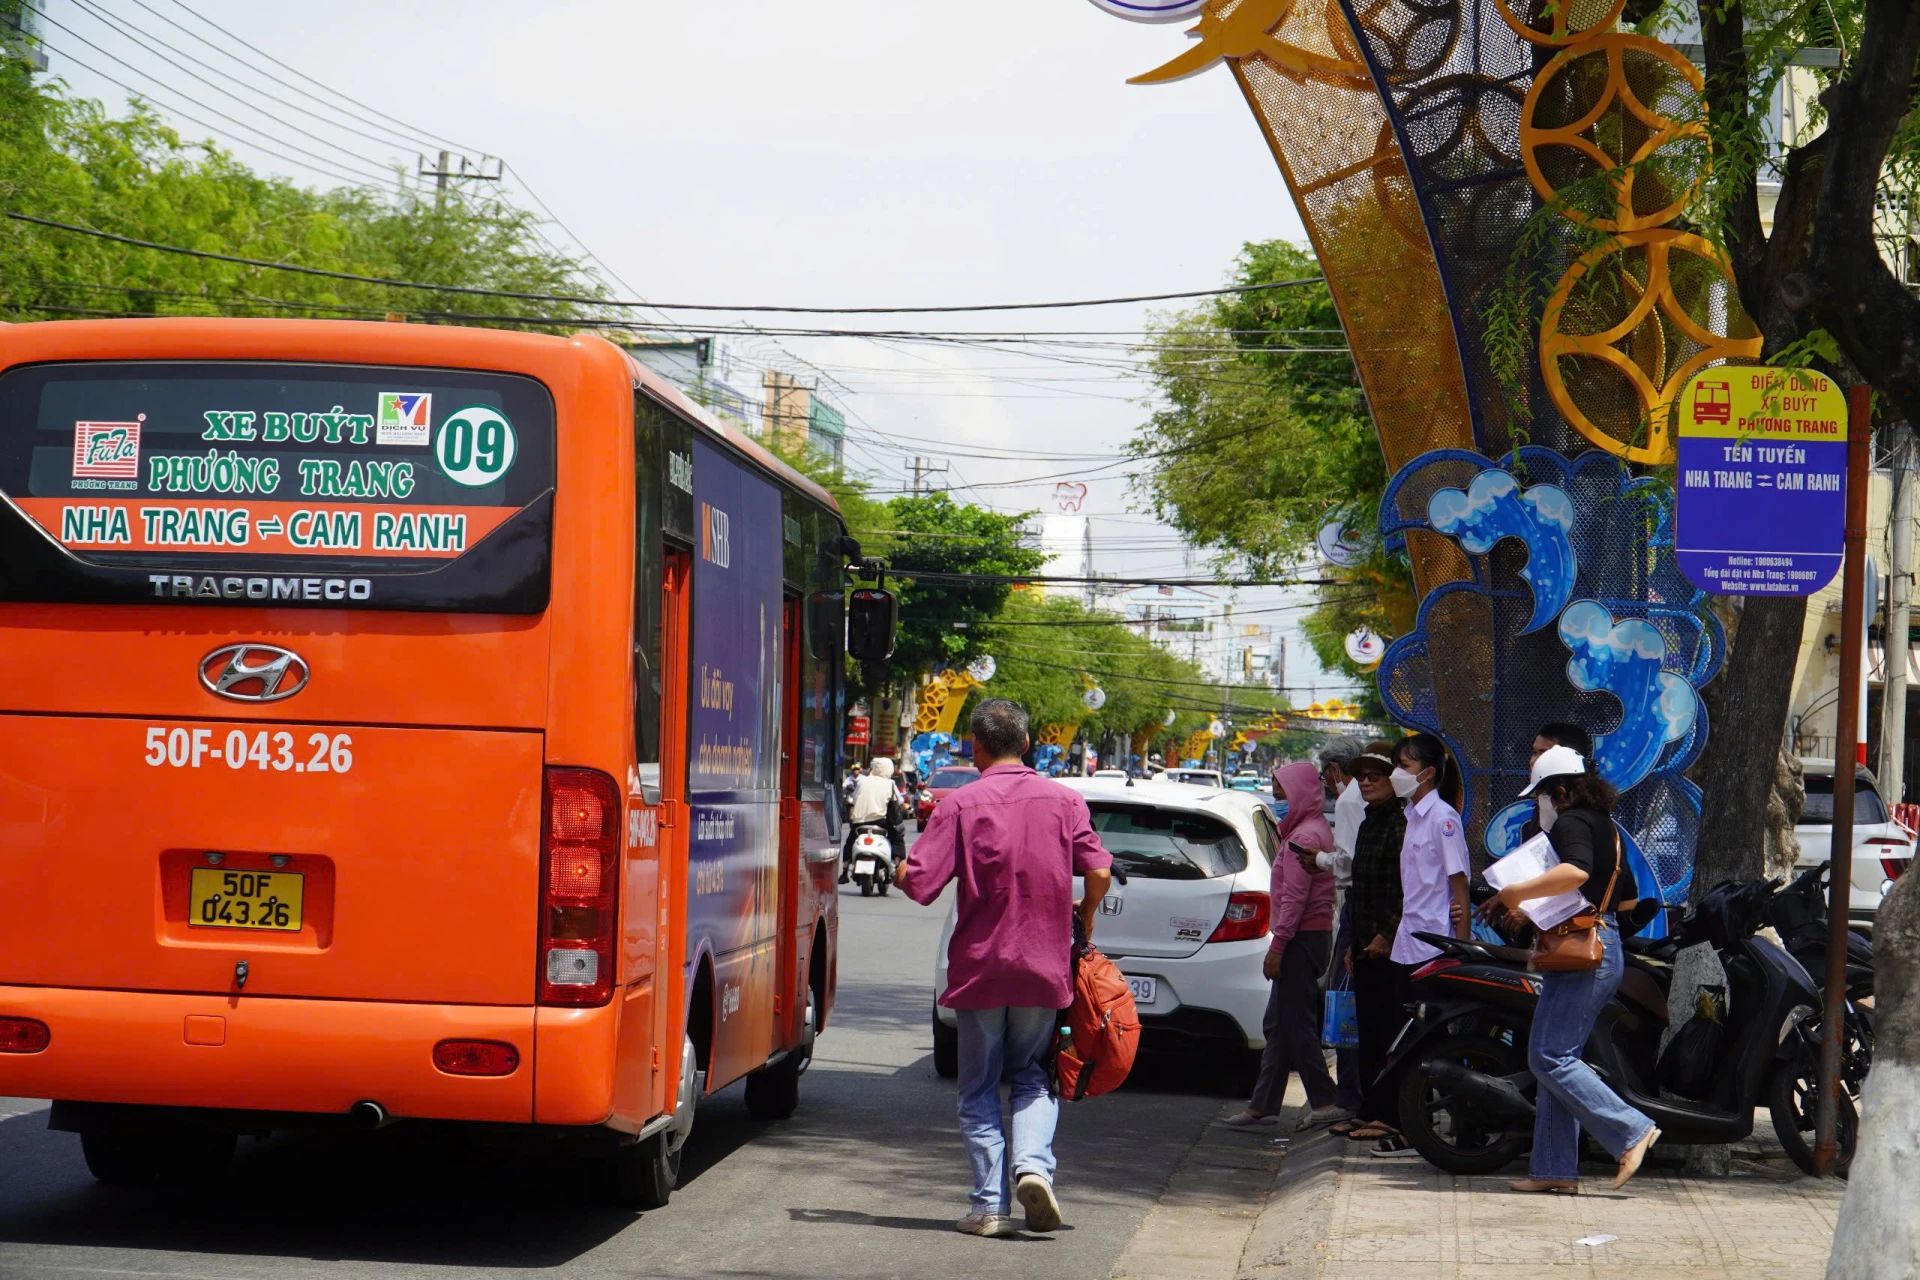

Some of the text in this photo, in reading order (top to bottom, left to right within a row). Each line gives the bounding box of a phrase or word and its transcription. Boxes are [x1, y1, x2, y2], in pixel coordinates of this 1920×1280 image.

[1783, 394, 1817, 412] BUÝT
[202, 405, 375, 444] XE BUÝT
[1796, 420, 1838, 434] TRANG
[442, 418, 509, 473] 09
[1758, 444, 1806, 464] TUYẾN
[108, 480, 138, 490] TRANG
[148, 449, 416, 498] PHƯƠNG TRANG
[1685, 470, 1840, 492] NHA TRANG CAM RANH
[61, 505, 467, 553] NHA TRANG CAM RANH
[711, 506, 730, 569] SHB
[1728, 556, 1753, 566] Hotline:
[149, 574, 372, 601] TRACOMECO
[1722, 581, 1748, 590] Website:
[1752, 570, 1764, 579] Nha
[1766, 570, 1786, 580] Trang:
[144, 727, 354, 773] 50F-043.26
[699, 732, 711, 775] cho
[222, 873, 272, 899] 50F
[202, 898, 290, 928] 043.26
